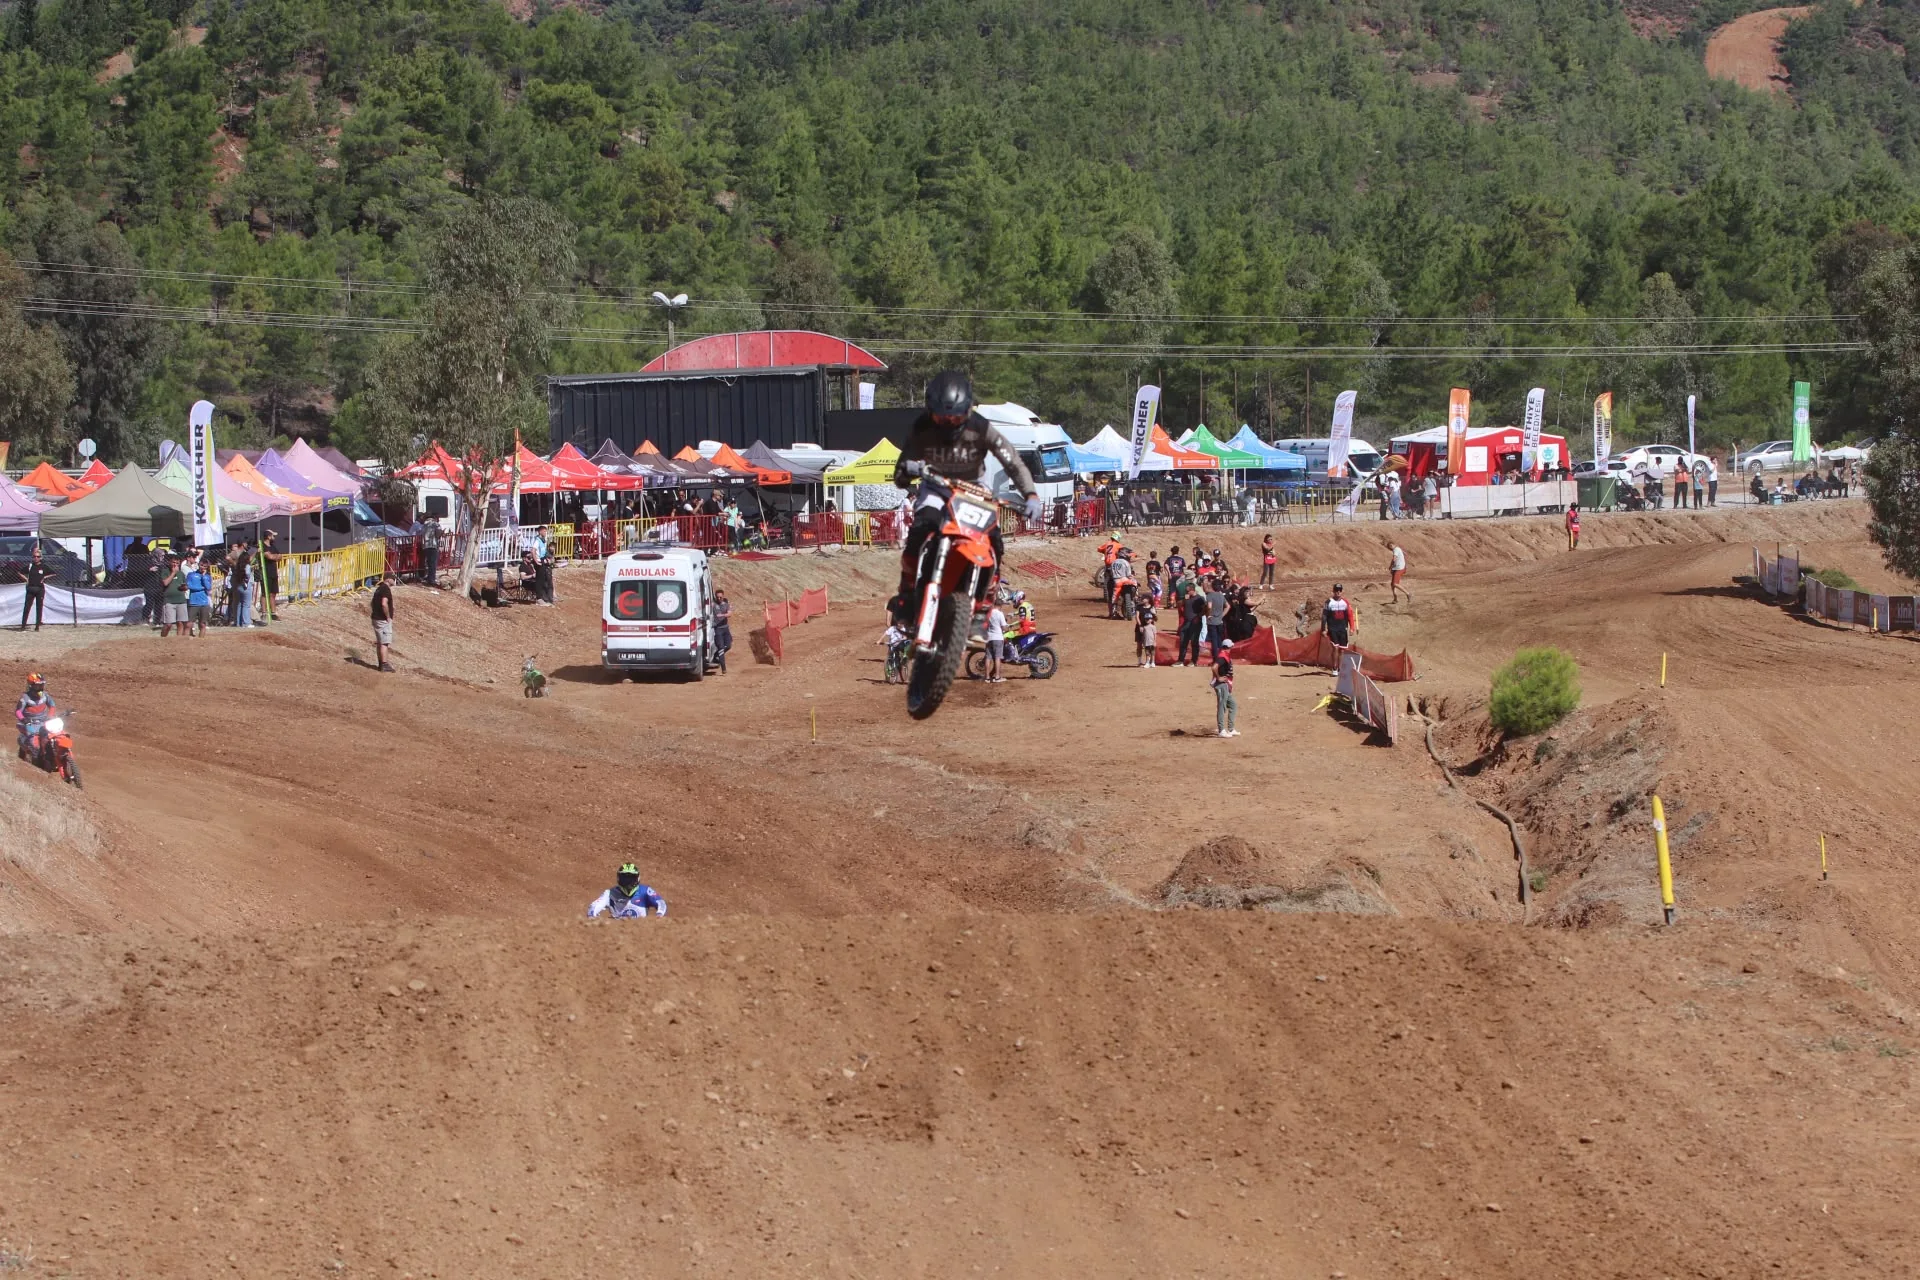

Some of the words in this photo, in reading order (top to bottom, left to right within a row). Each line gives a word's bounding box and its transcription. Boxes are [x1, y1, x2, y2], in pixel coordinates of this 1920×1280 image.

[1132, 400, 1150, 466] KÄRCHER
[1523, 397, 1536, 447] FETHİYE
[1531, 399, 1542, 448] BELEDİYESİ
[194, 424, 207, 525] KÄRCHER
[327, 496, 350, 508] SHERCO
[956, 502, 993, 528] 151
[617, 567, 676, 577] AMBULANS
